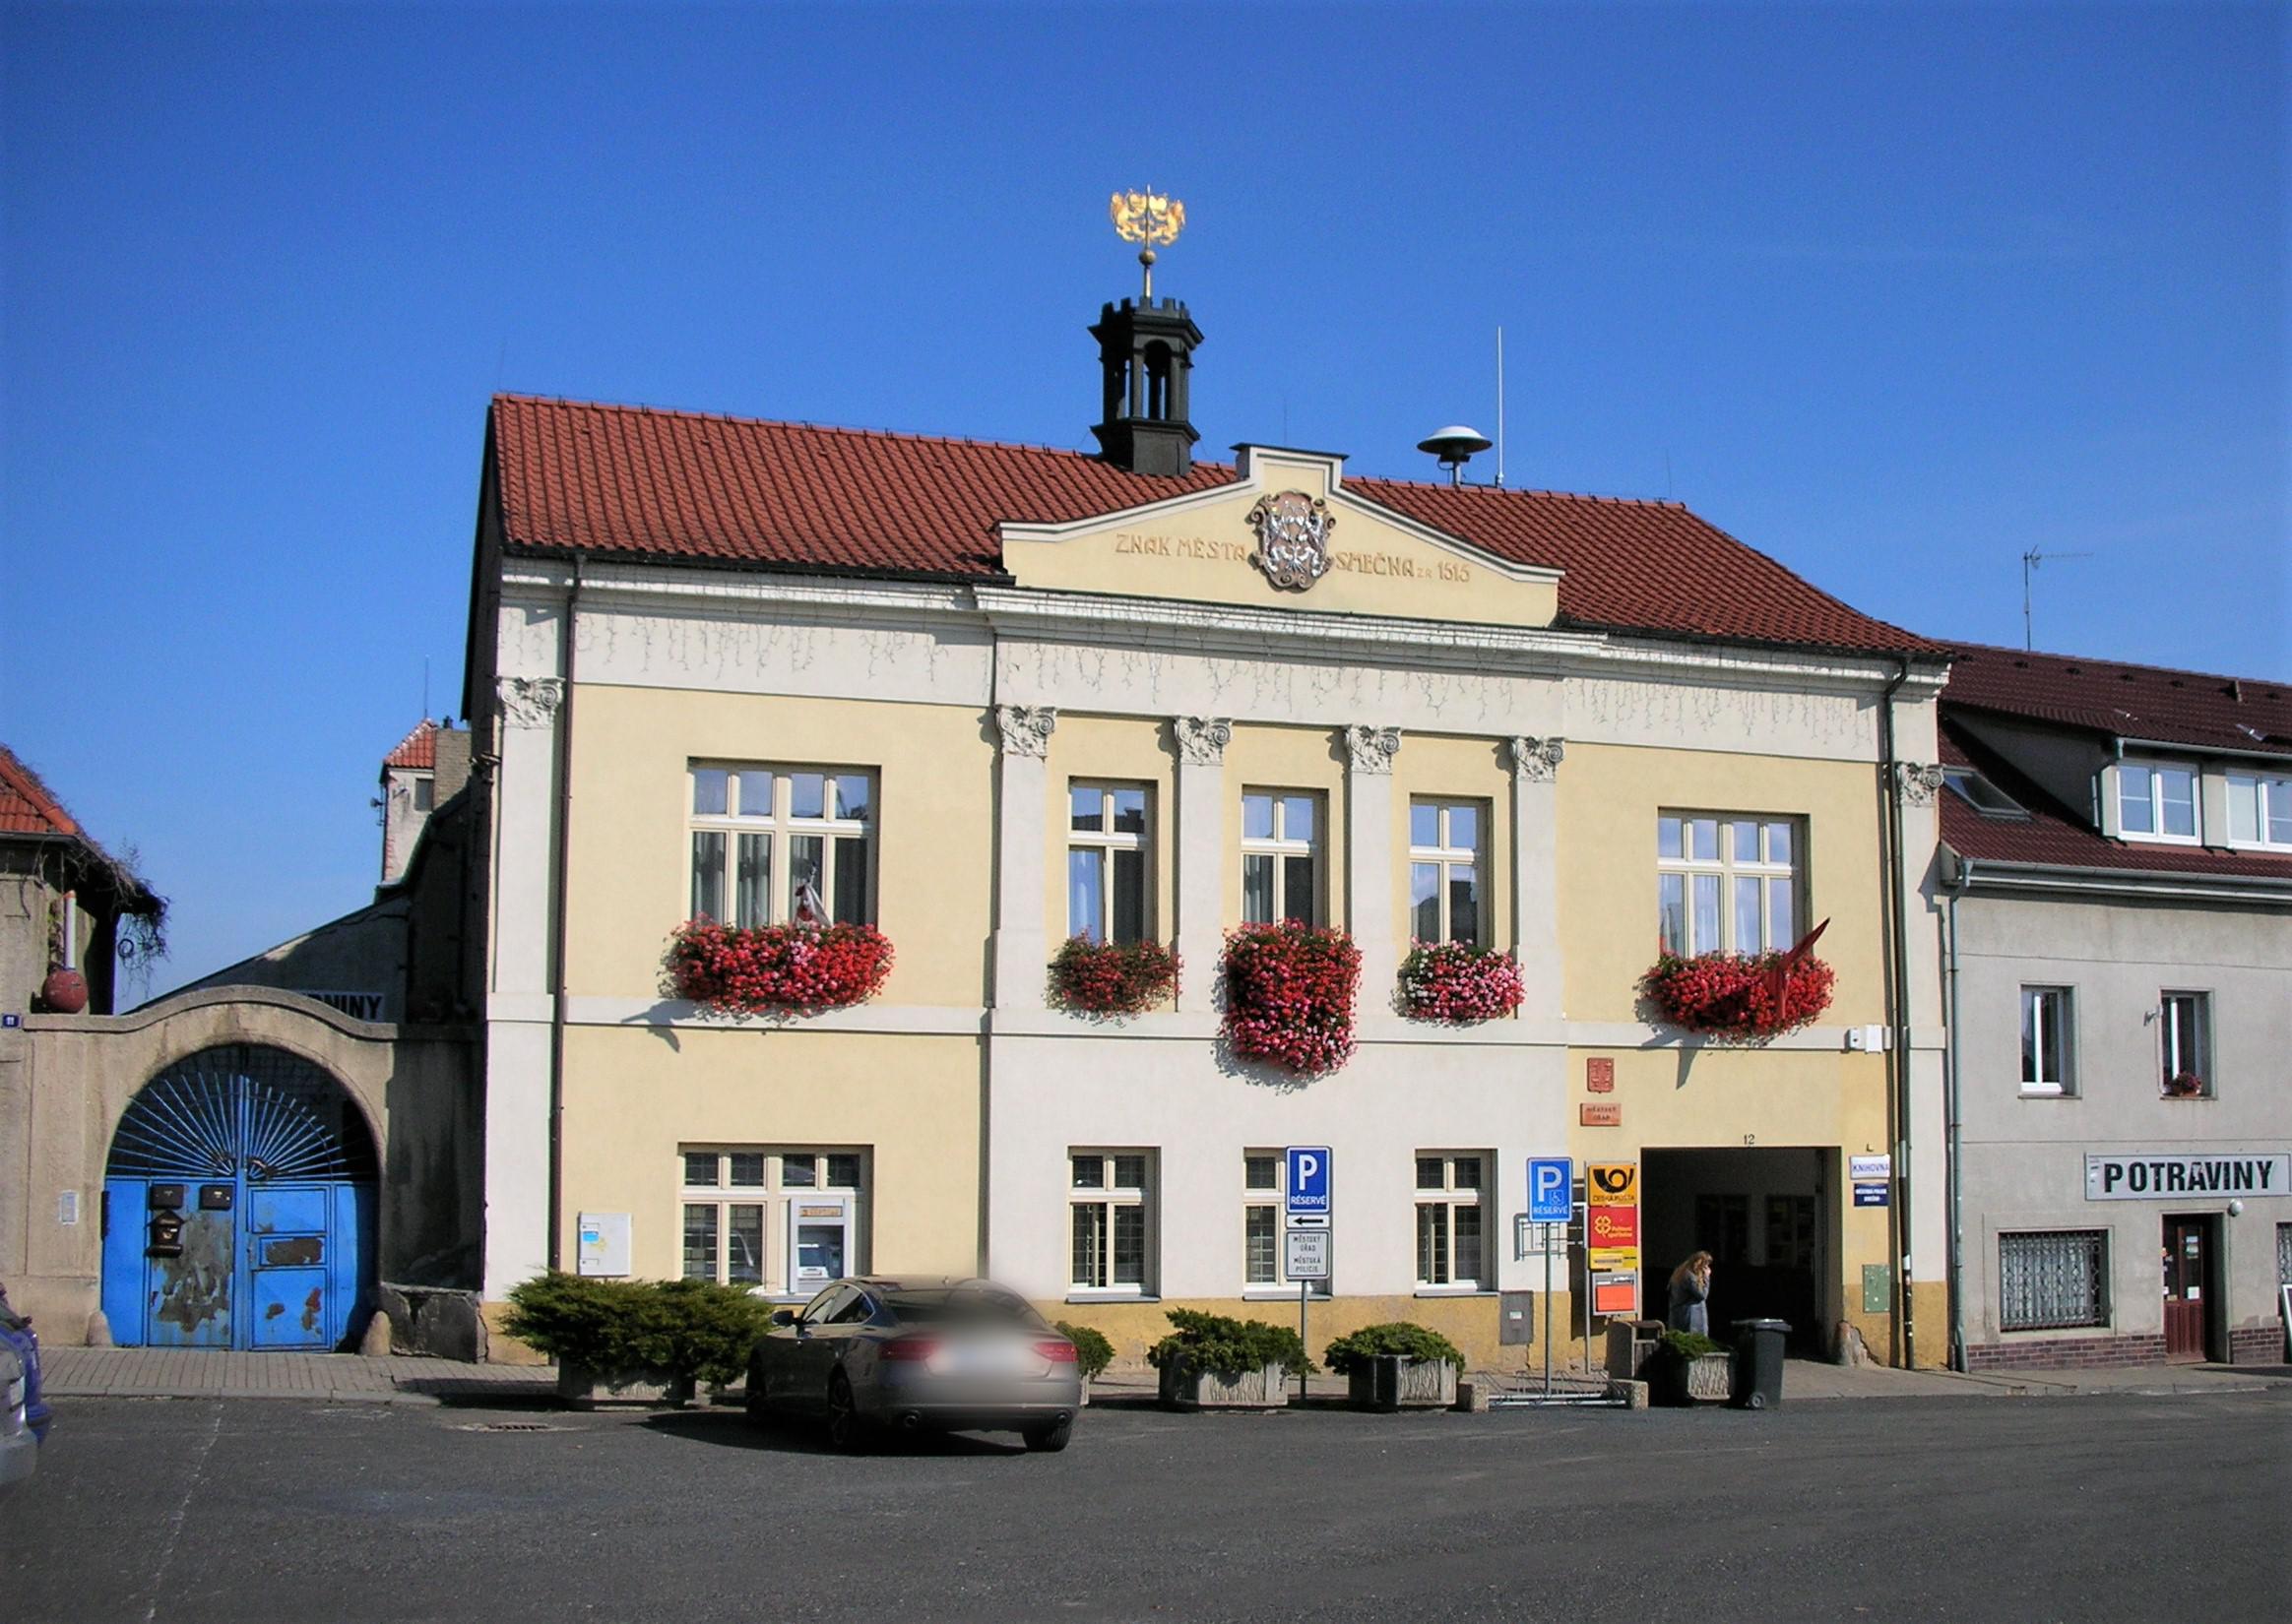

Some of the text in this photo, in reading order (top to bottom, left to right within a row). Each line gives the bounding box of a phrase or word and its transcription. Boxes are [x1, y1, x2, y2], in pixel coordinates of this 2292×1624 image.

[1744, 1134, 1755, 1145] 12
[1299, 1154, 1318, 1191] P
[1537, 1165, 1562, 1202] P
[2103, 1160, 2273, 1193] POTRAVINY
